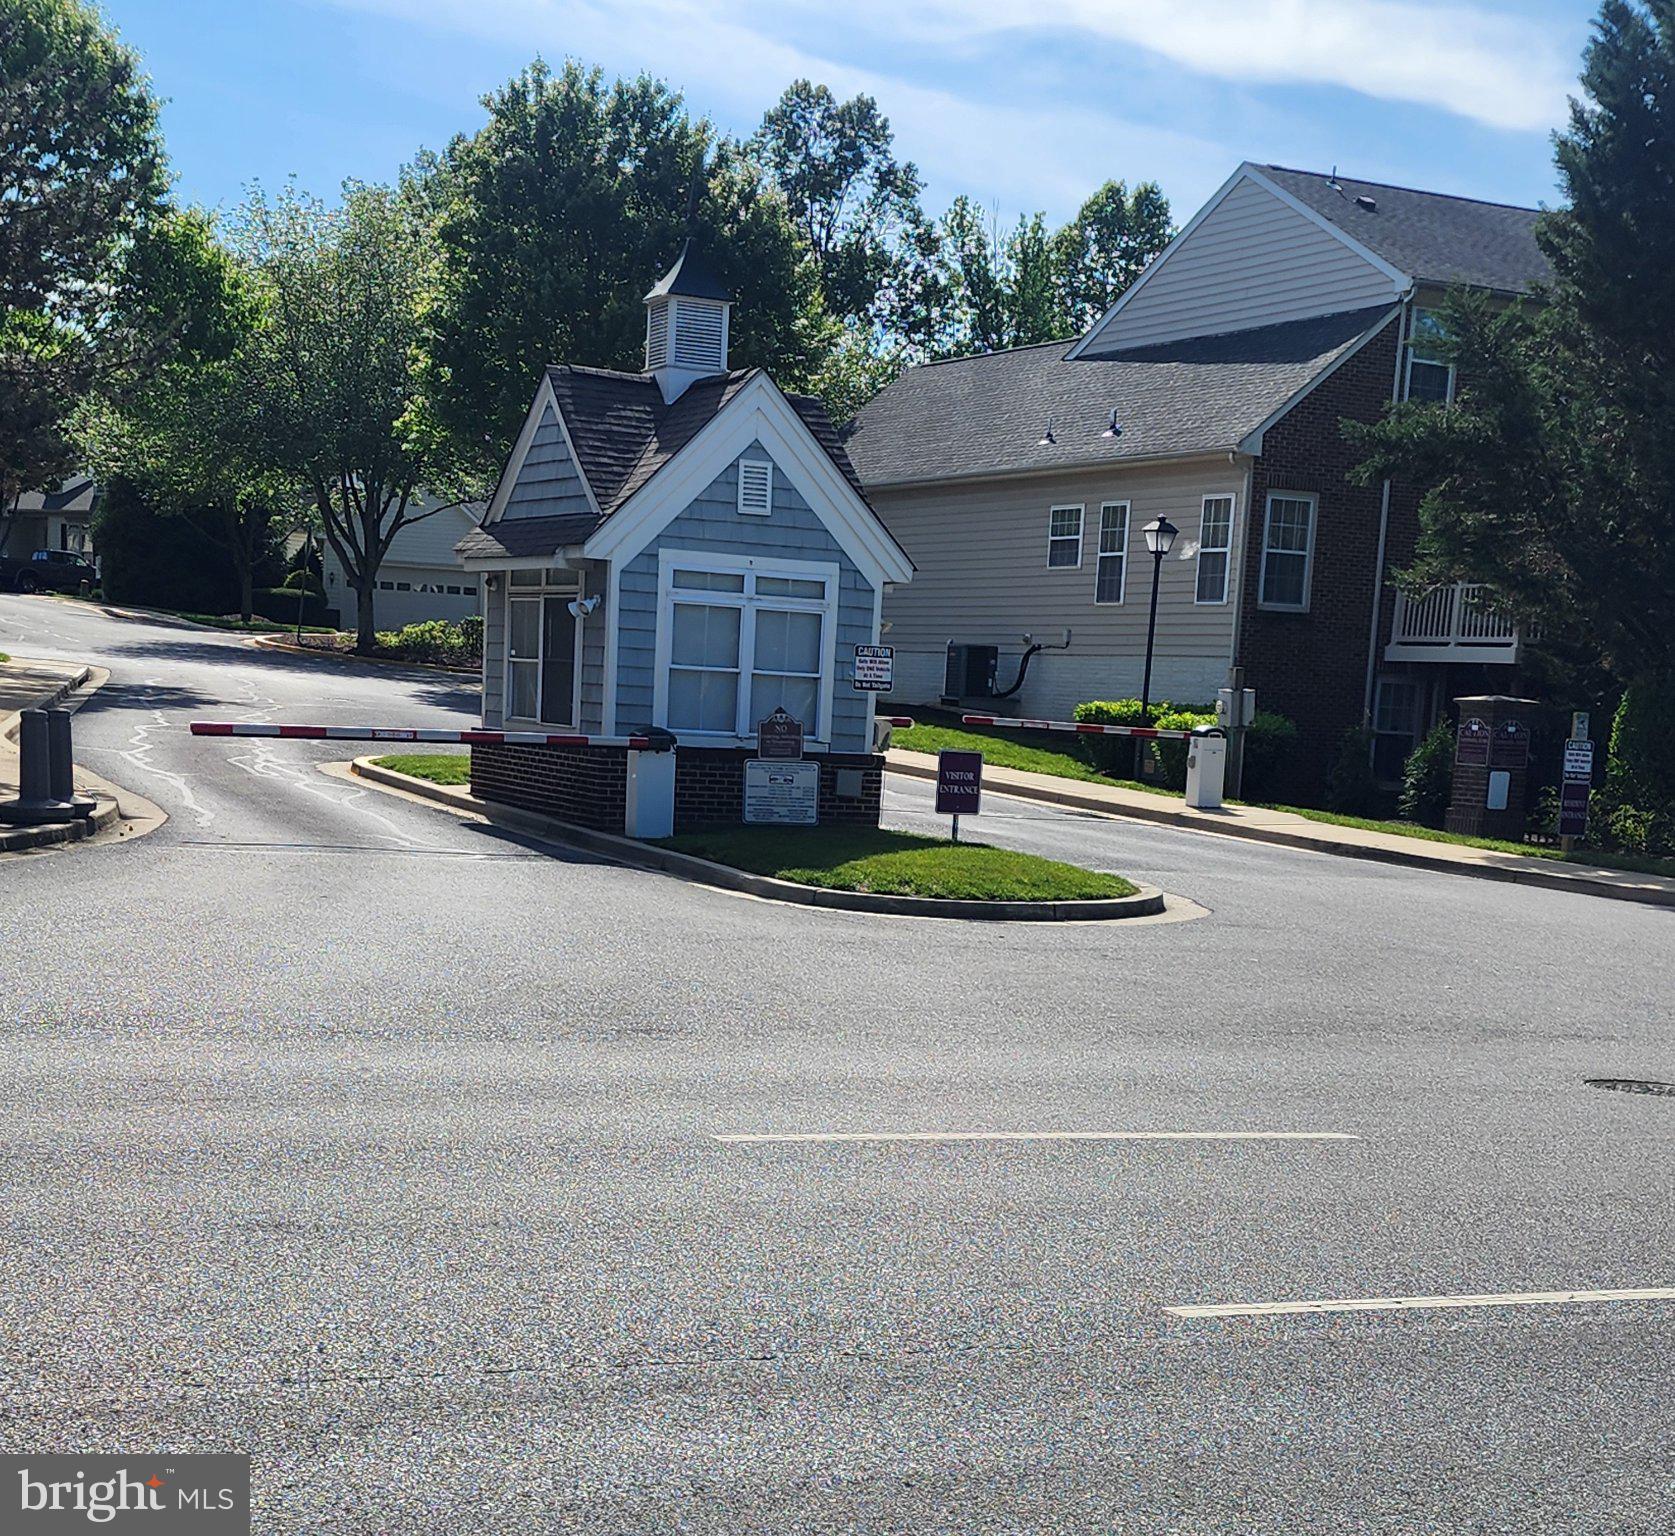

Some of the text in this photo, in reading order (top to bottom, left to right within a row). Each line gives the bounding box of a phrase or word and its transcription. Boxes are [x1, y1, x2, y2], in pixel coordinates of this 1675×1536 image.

[858, 646, 891, 657] CAUTION
[775, 725, 788, 734] NO
[1568, 741, 1591, 750] CAUTION
[945, 771, 975, 781] VISITOR
[939, 784, 978, 795] ENTRANCE
